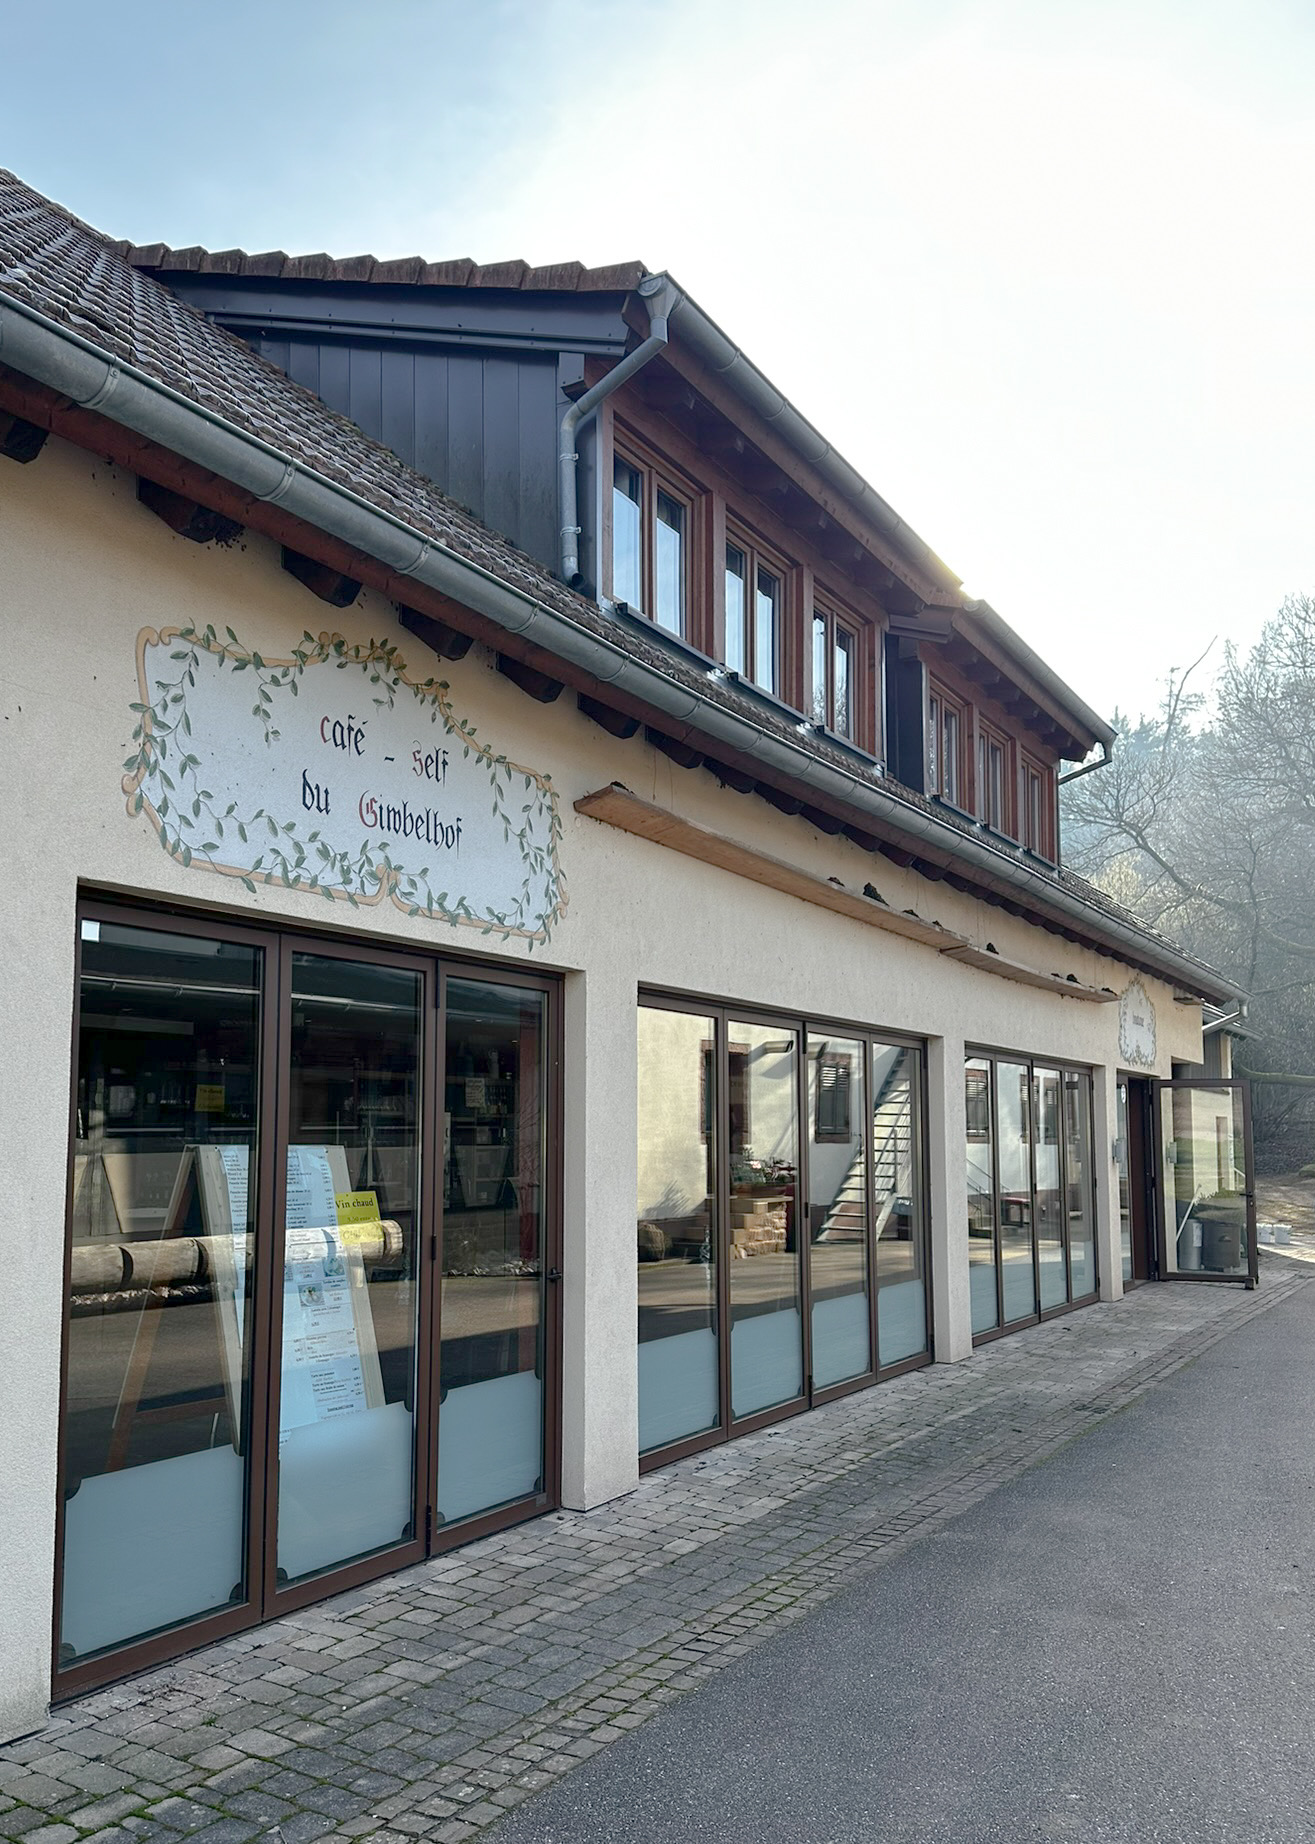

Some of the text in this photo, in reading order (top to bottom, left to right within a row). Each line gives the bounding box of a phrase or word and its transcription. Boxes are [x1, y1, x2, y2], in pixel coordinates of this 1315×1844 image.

[302, 769, 462, 859] du Gimbelhof
[335, 1199, 350, 1209] Vin
[352, 1198, 374, 1208] chaud
